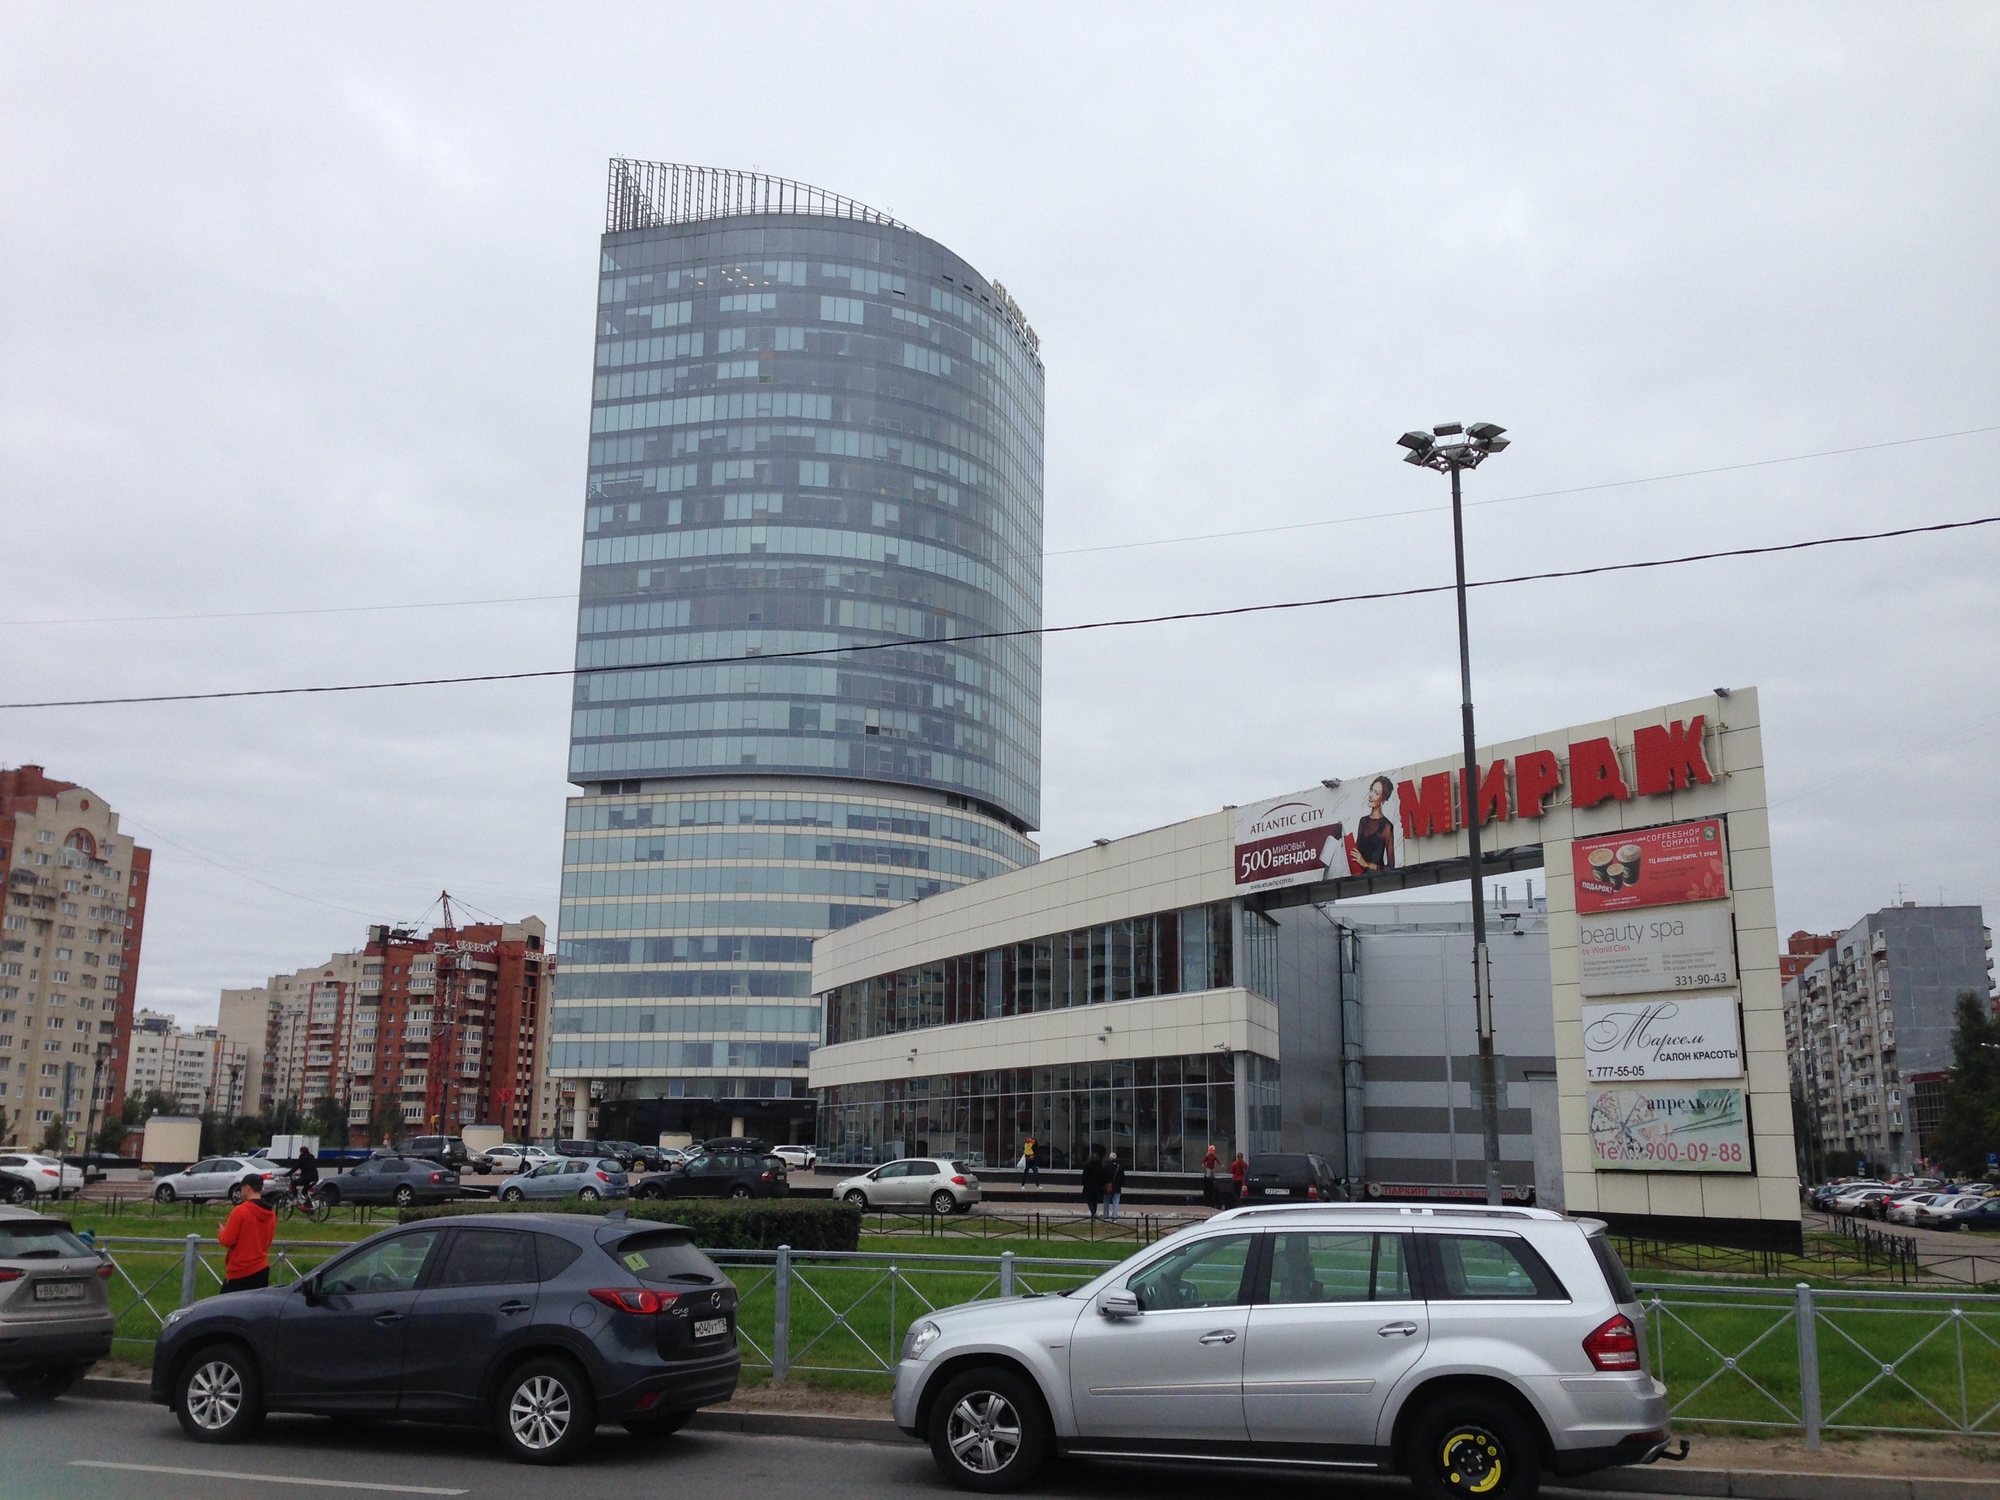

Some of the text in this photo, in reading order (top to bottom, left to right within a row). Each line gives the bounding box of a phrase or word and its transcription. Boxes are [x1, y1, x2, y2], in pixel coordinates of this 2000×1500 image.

[1396, 714, 1716, 839] МИРАЖ
[1250, 808, 1325, 834] ATLANTIC CITY
[1646, 828, 1700, 842] COFFEESHOP
[1661, 837, 1701, 848] COMPANY
[1240, 841, 1306, 879] 500 МИРОВЫХ
[1272, 848, 1317, 867] БРЕНДОВ
[1581, 881, 1612, 893] ПОДАРОК!
[1580, 920, 1685, 944] beauty spa
[1591, 945, 1613, 954] World
[1613, 944, 1630, 952] Class
[1675, 972, 1727, 986] 331-90-43
[1584, 1001, 1704, 1062] Марсель
[1659, 1049, 1738, 1062] САЛОН КРАСОТЫ
[1587, 1066, 1645, 1077] т. 777-55-05
[1645, 1142, 1742, 1162] 900-09-88
[1384, 1186, 1430, 1195] ПАРКИНГ
[1466, 1190, 1513, 1198] БЕСПНО
